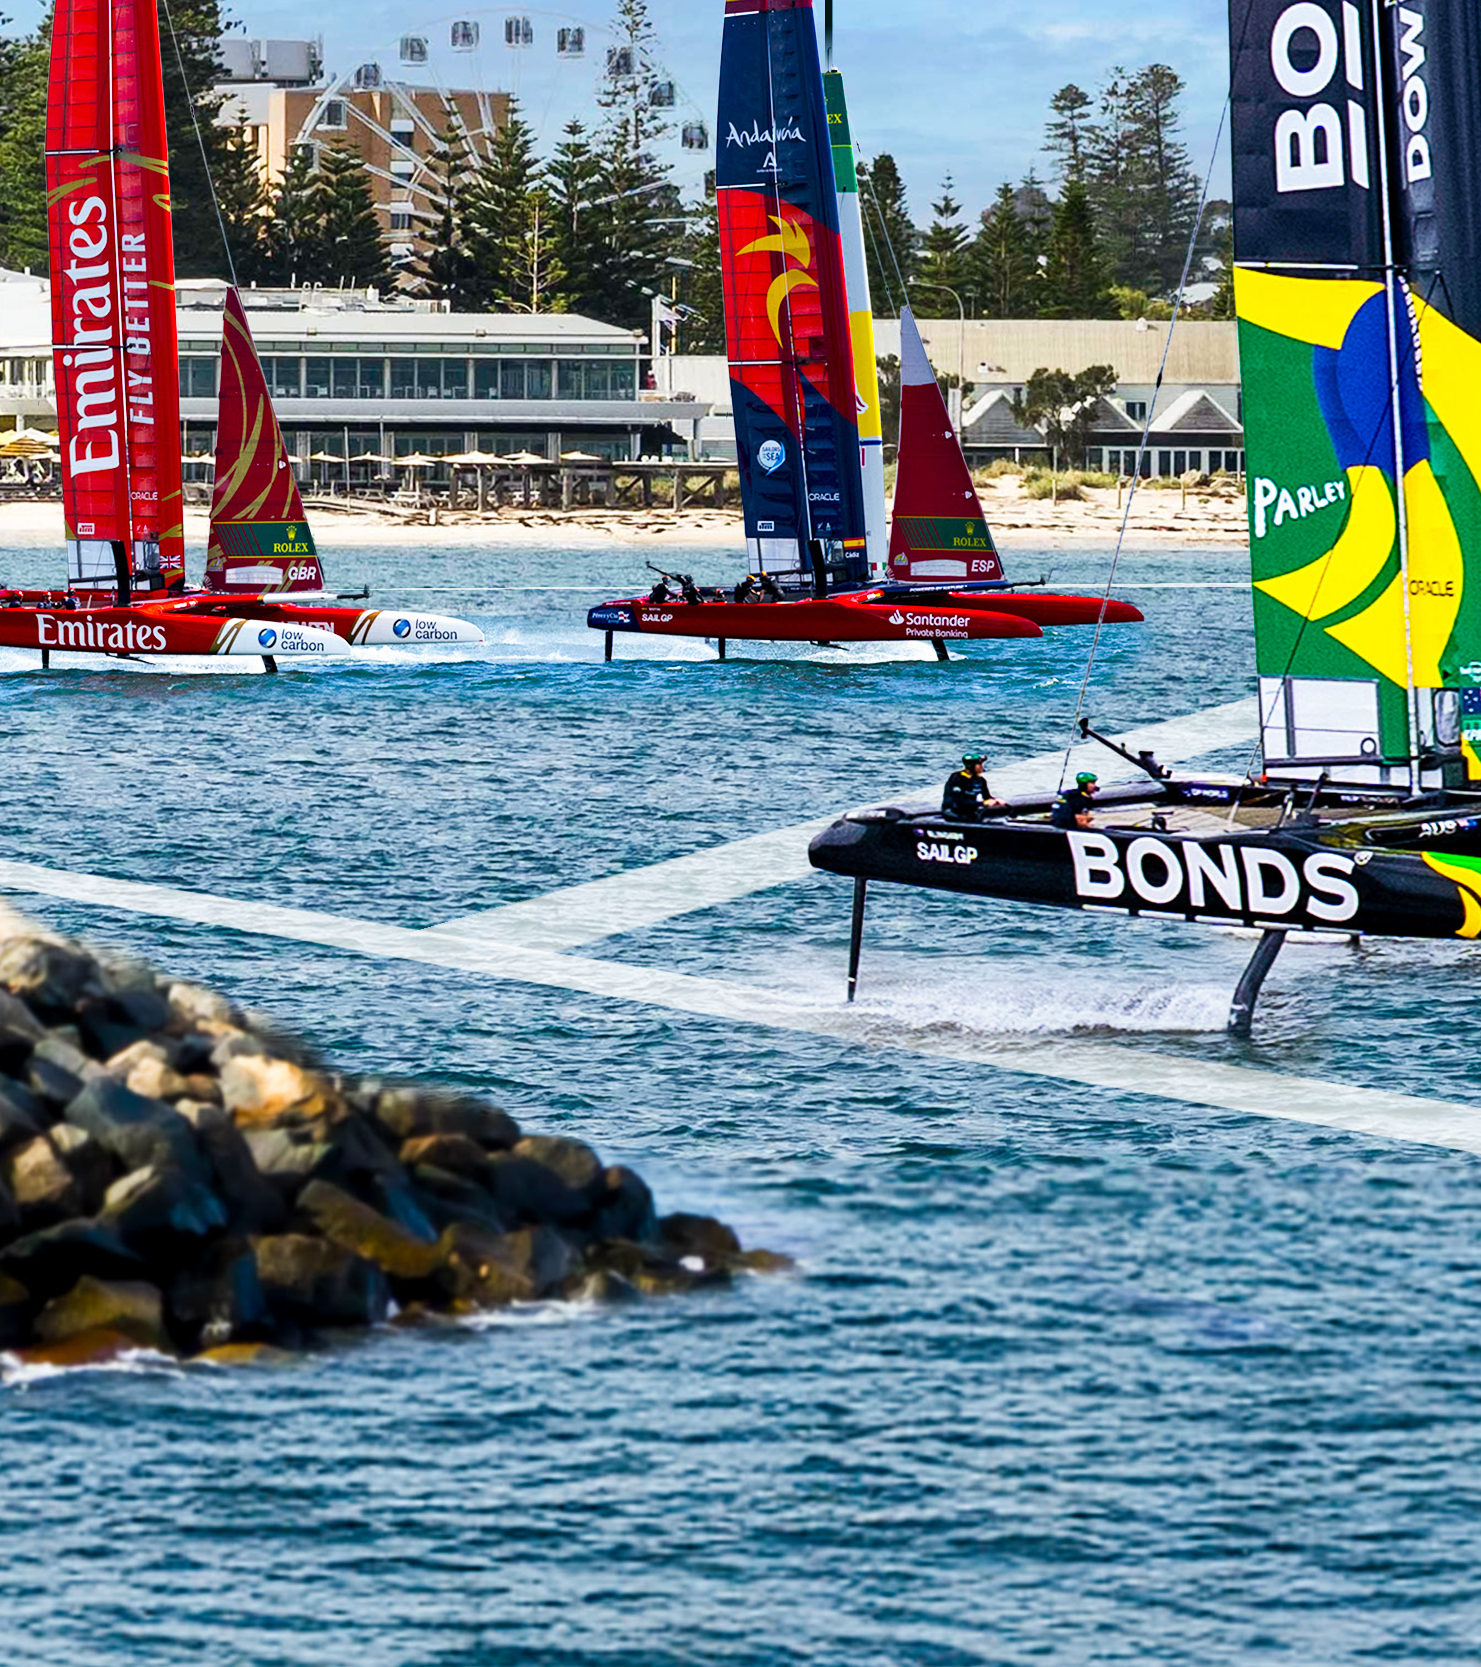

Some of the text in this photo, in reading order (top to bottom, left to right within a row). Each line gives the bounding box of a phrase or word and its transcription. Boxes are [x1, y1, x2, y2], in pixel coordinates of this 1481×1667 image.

[121, 232, 155, 425] FLY BETTER
[62, 195, 120, 479] Emirates
[130, 491, 159, 501] ORACLE
[808, 492, 840, 502] ORACLE
[1254, 476, 1348, 537] PARLEY
[273, 542, 309, 553] ROLEX
[953, 537, 987, 548] ROLEX
[971, 559, 995, 572] ESP
[288, 565, 317, 581] GBR
[1409, 579, 1454, 597] ORACLE
[416, 618, 437, 630] low
[641, 613, 674, 623] SAILGP
[906, 612, 971, 627] Santander
[35, 613, 167, 651] Emirates
[281, 629, 305, 640] low
[415, 628, 458, 640] carbon
[906, 627, 969, 638] Private Banking
[281, 639, 325, 652] carbon
[917, 841, 978, 865] SAILGP
[1066, 830, 1361, 922] BONDS
